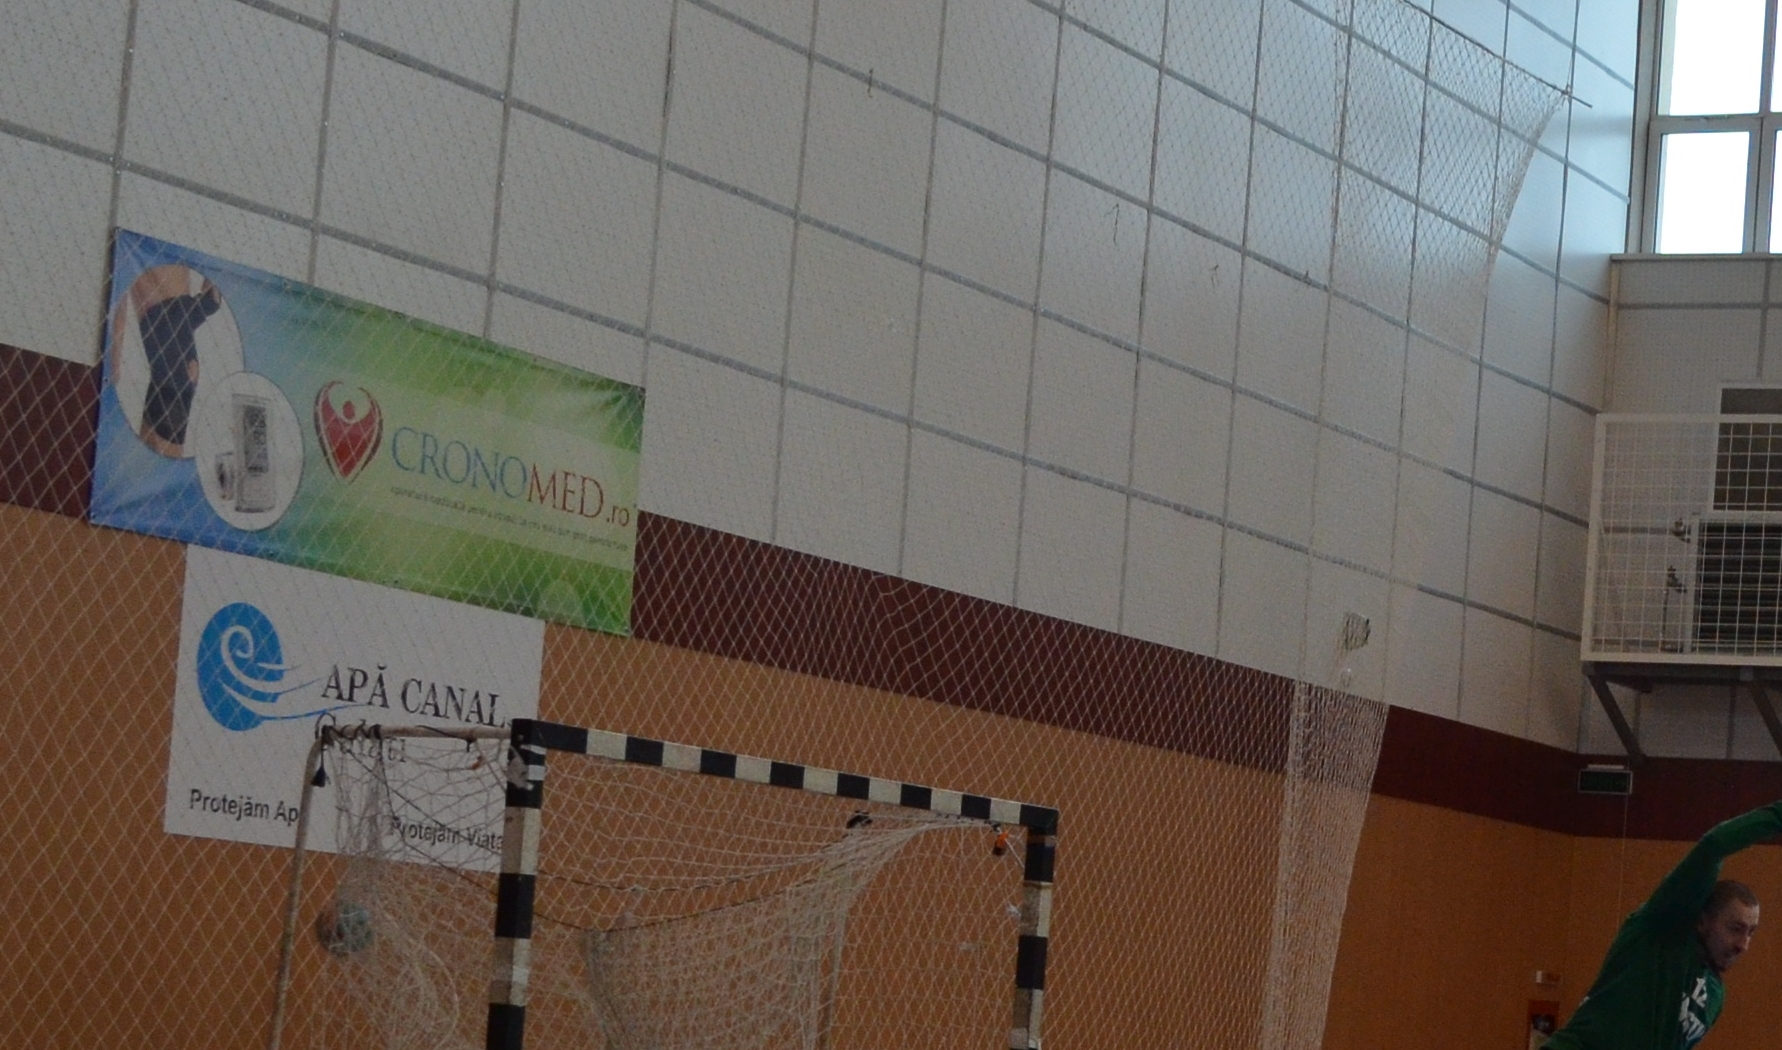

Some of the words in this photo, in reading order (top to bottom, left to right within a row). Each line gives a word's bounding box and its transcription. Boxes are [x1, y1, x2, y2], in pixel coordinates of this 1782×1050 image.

[321, 662, 390, 709] APĂ
[401, 677, 506, 729] CANAL
[189, 788, 270, 822] Protejăm
